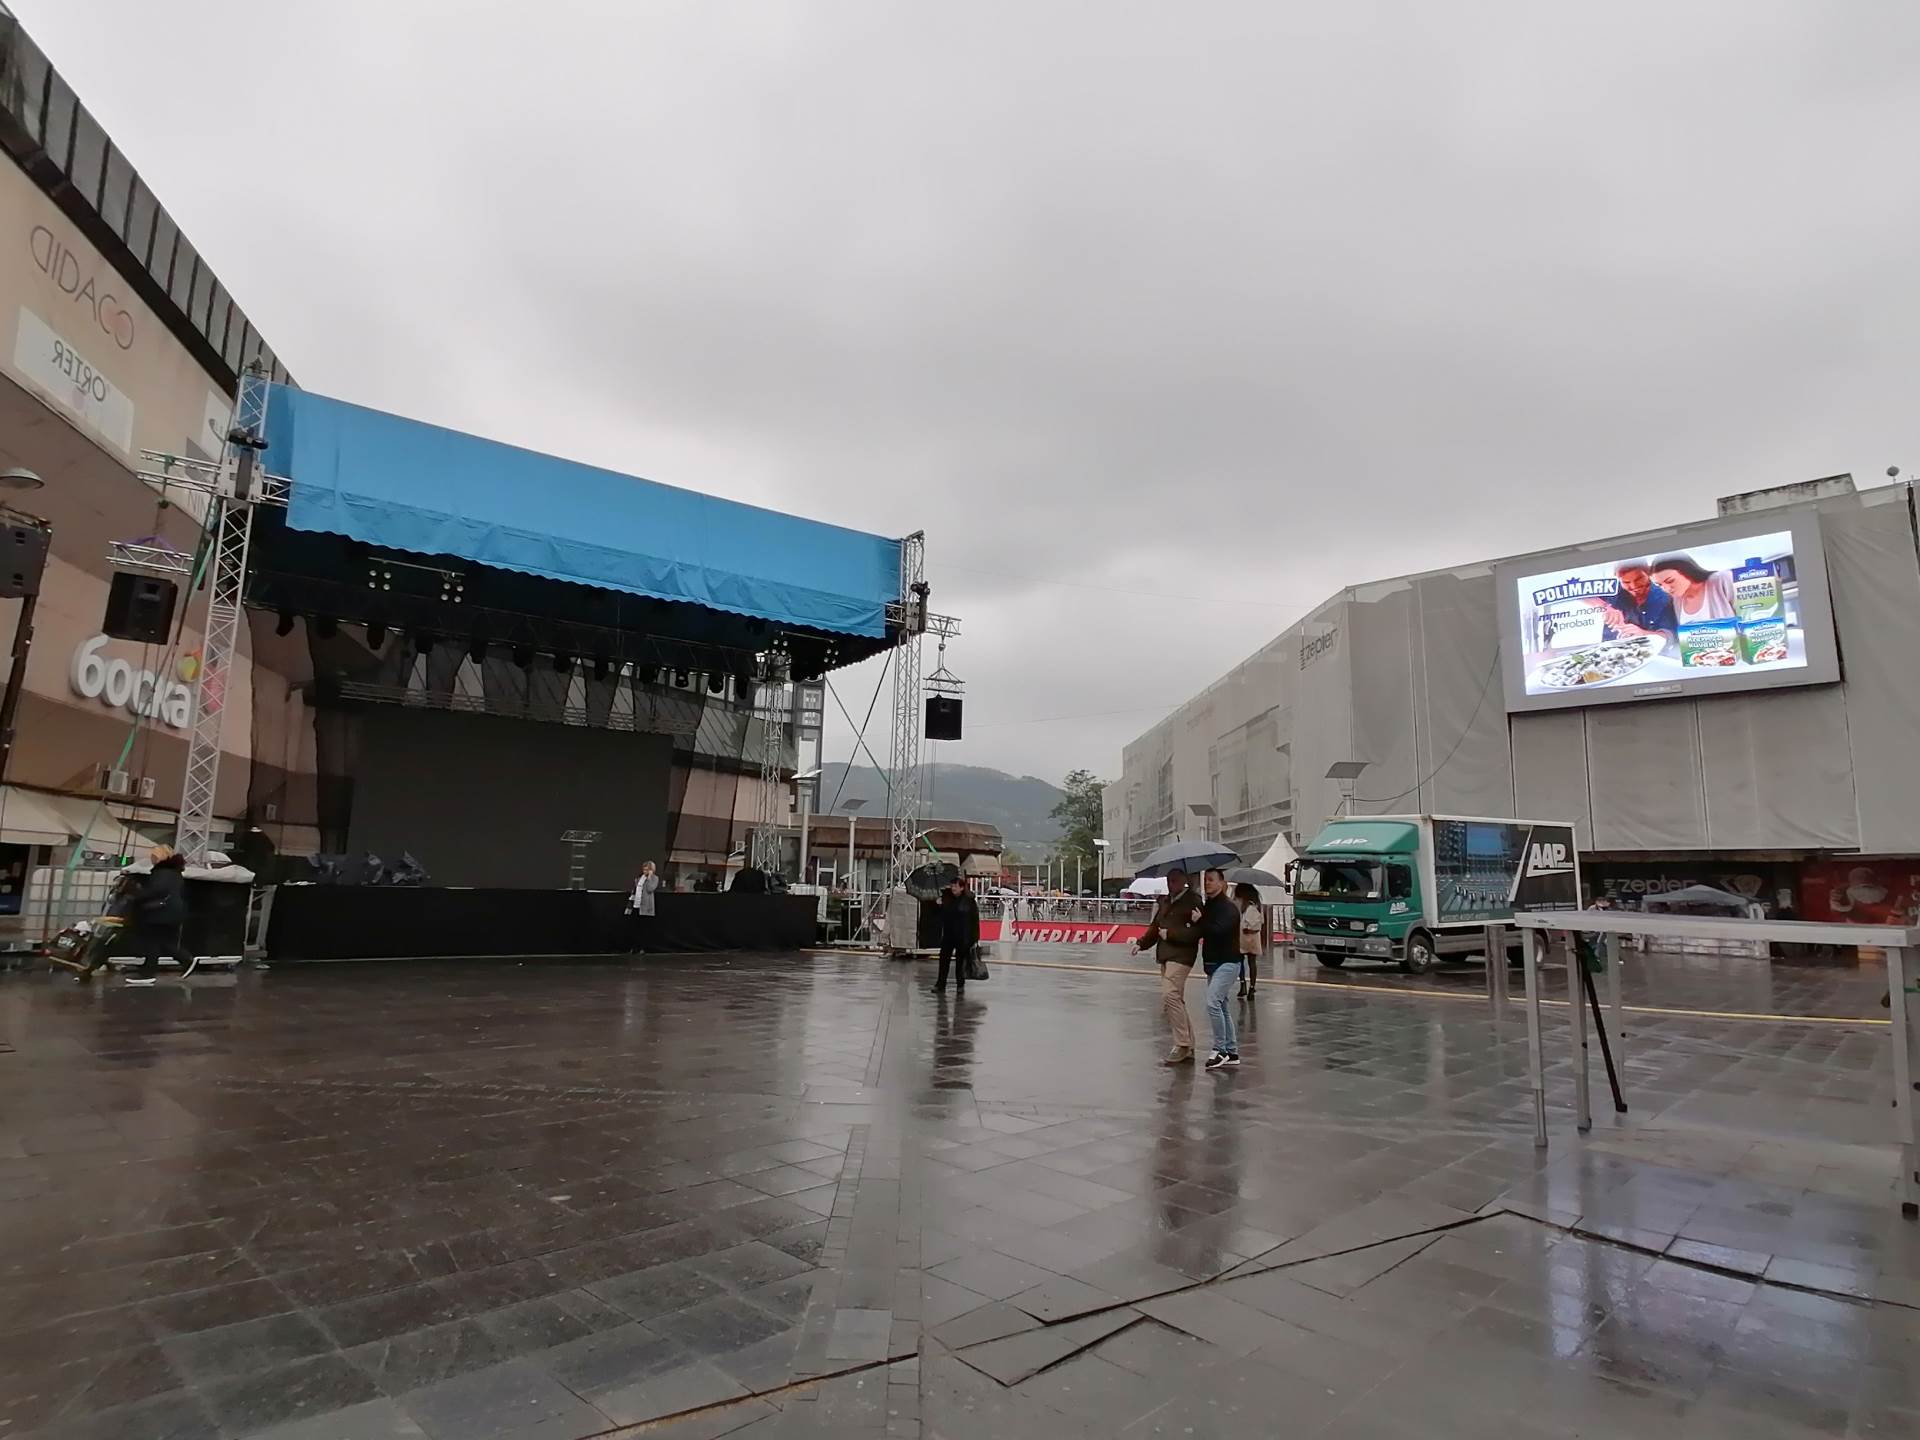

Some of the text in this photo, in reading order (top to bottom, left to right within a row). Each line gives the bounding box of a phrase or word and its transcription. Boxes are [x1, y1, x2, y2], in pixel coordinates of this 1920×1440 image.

[1535, 580, 1616, 604] POLIMARK
[1736, 581, 1774, 593] KREM ZA
[1736, 589, 1775, 601] KUVANJE
[1559, 618, 1595, 631] probati
[1305, 628, 1338, 661] zepter
[1325, 838, 1368, 846] AAP
[1529, 843, 1567, 869] AAP
[1617, 874, 1697, 895] zepter
